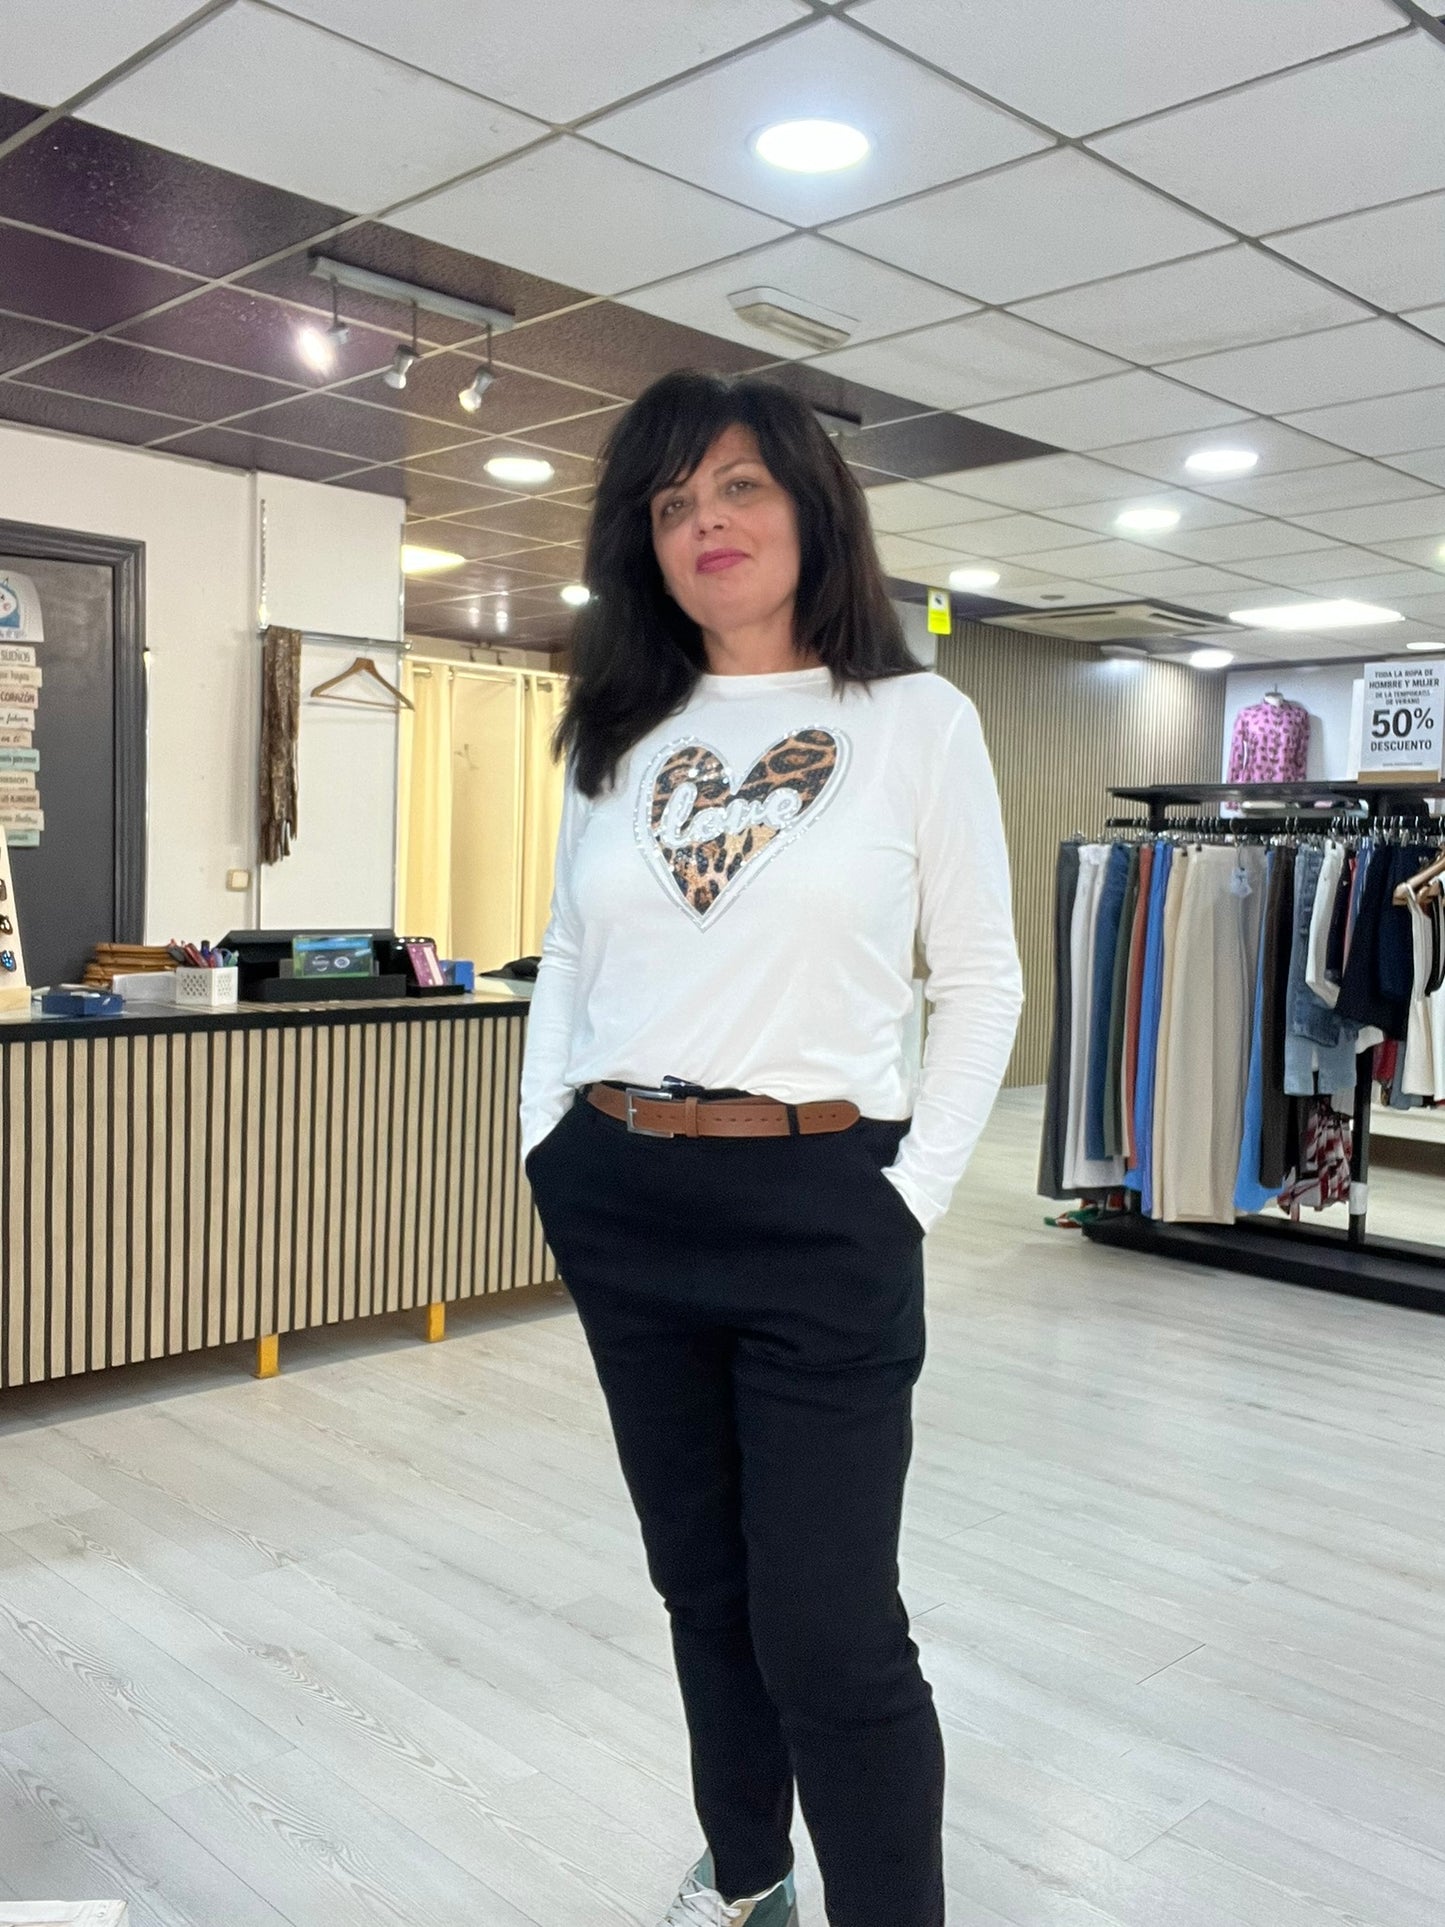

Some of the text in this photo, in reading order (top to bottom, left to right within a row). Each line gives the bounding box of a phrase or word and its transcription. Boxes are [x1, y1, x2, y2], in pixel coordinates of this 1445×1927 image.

[1394, 670, 1402, 678] LA
[1405, 669, 1422, 677] ROPA
[1425, 668, 1433, 676] DE
[1369, 677, 1440, 689] HOMBRE Y MUJER
[0, 691, 35, 705] CORAZÓN
[1371, 707, 1434, 738] 50%
[1370, 740, 1432, 752] DESCUENTO
